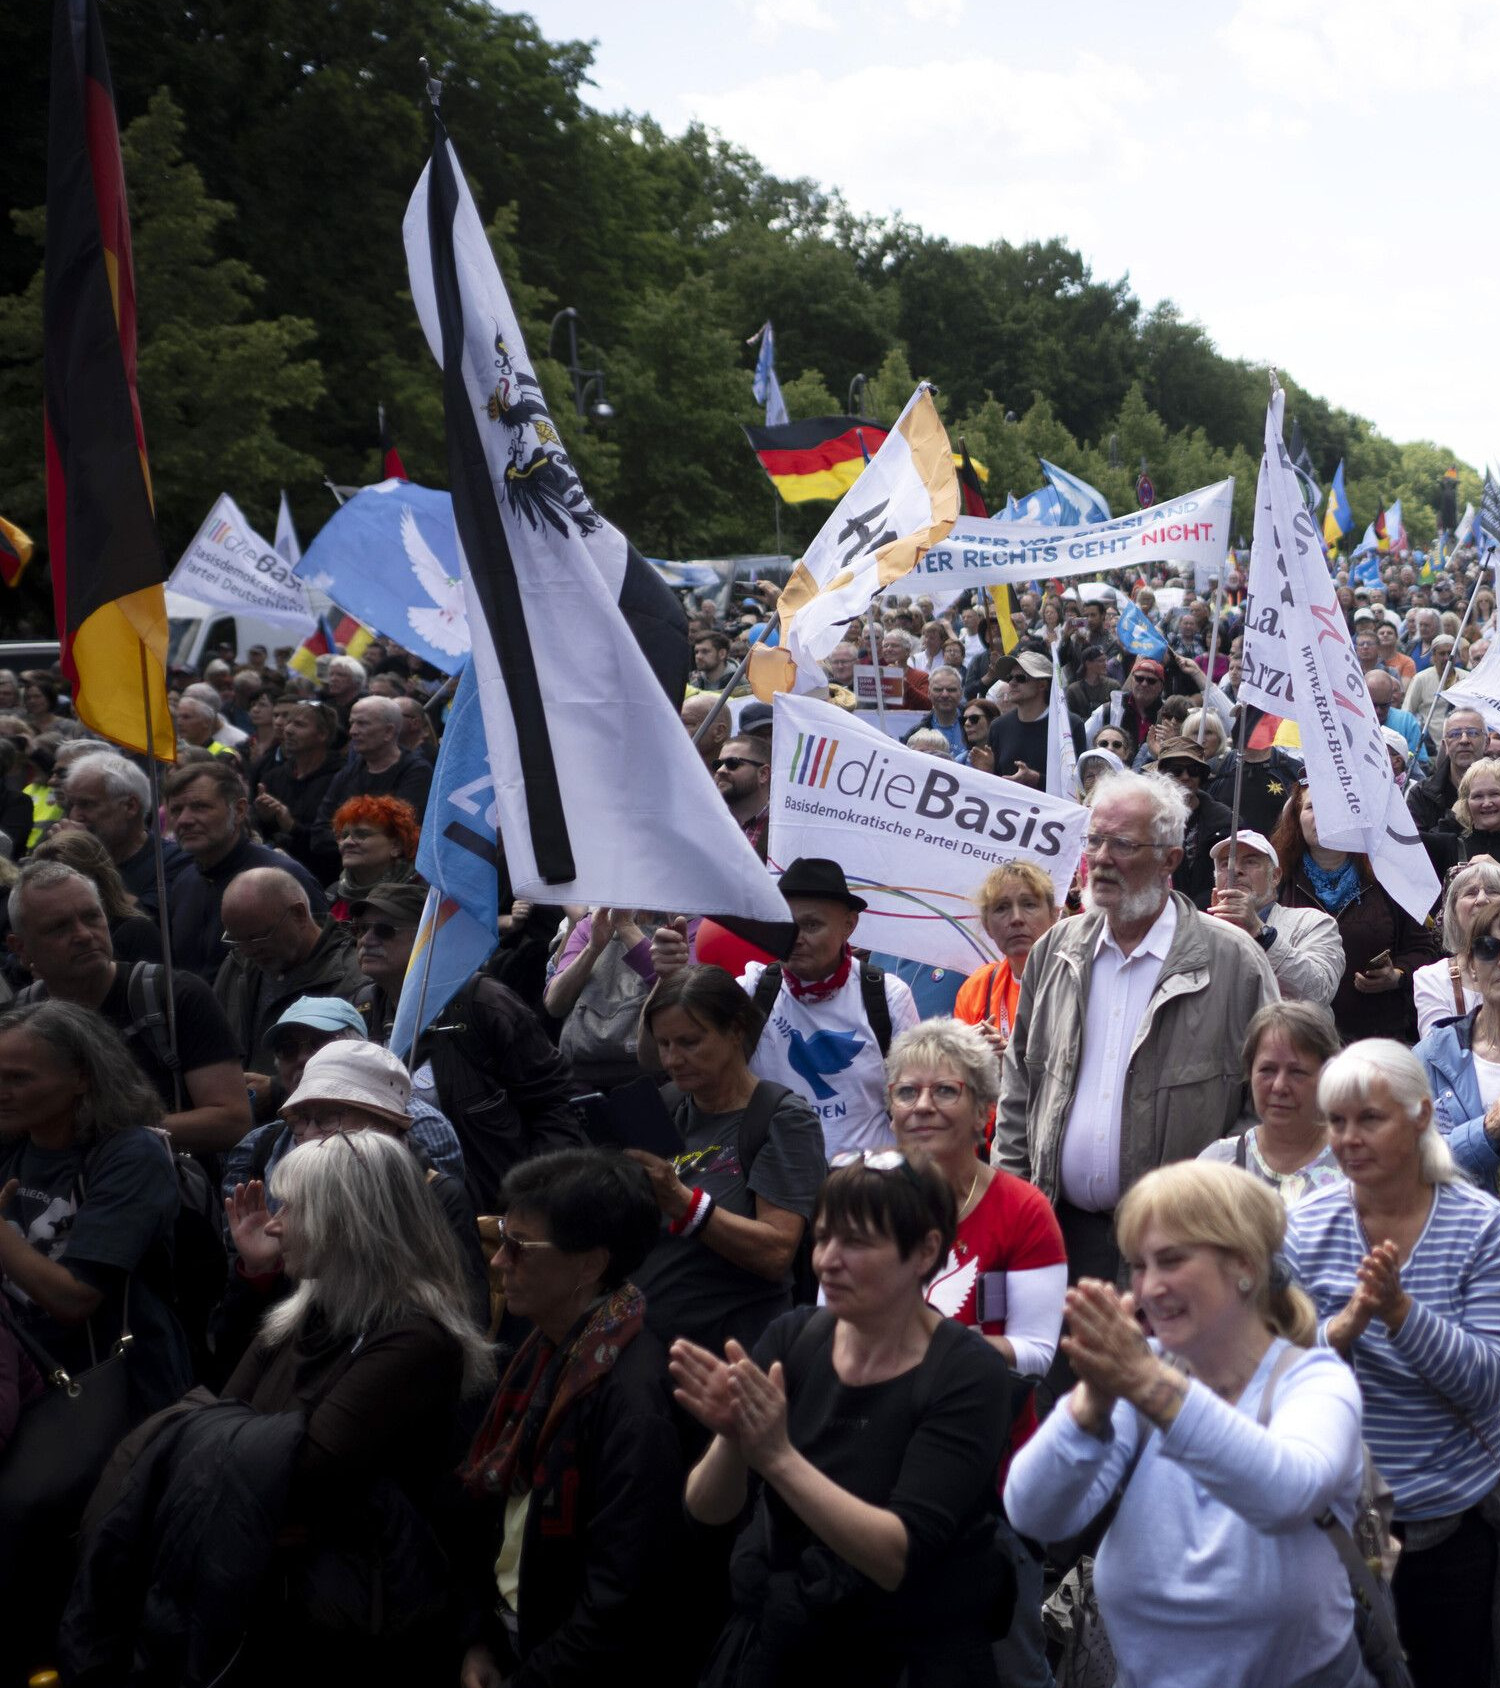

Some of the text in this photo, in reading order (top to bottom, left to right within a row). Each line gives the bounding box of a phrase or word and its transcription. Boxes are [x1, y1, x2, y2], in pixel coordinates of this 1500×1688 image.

[963, 546, 1058, 568] RECHTS
[1068, 536, 1132, 560] GEHT
[1301, 644, 1361, 815] www.RKI-Buch.de
[784, 795, 912, 838] Basisdemokratische
[914, 828, 959, 852] Partei
[836, 750, 1066, 857] dieBasis
